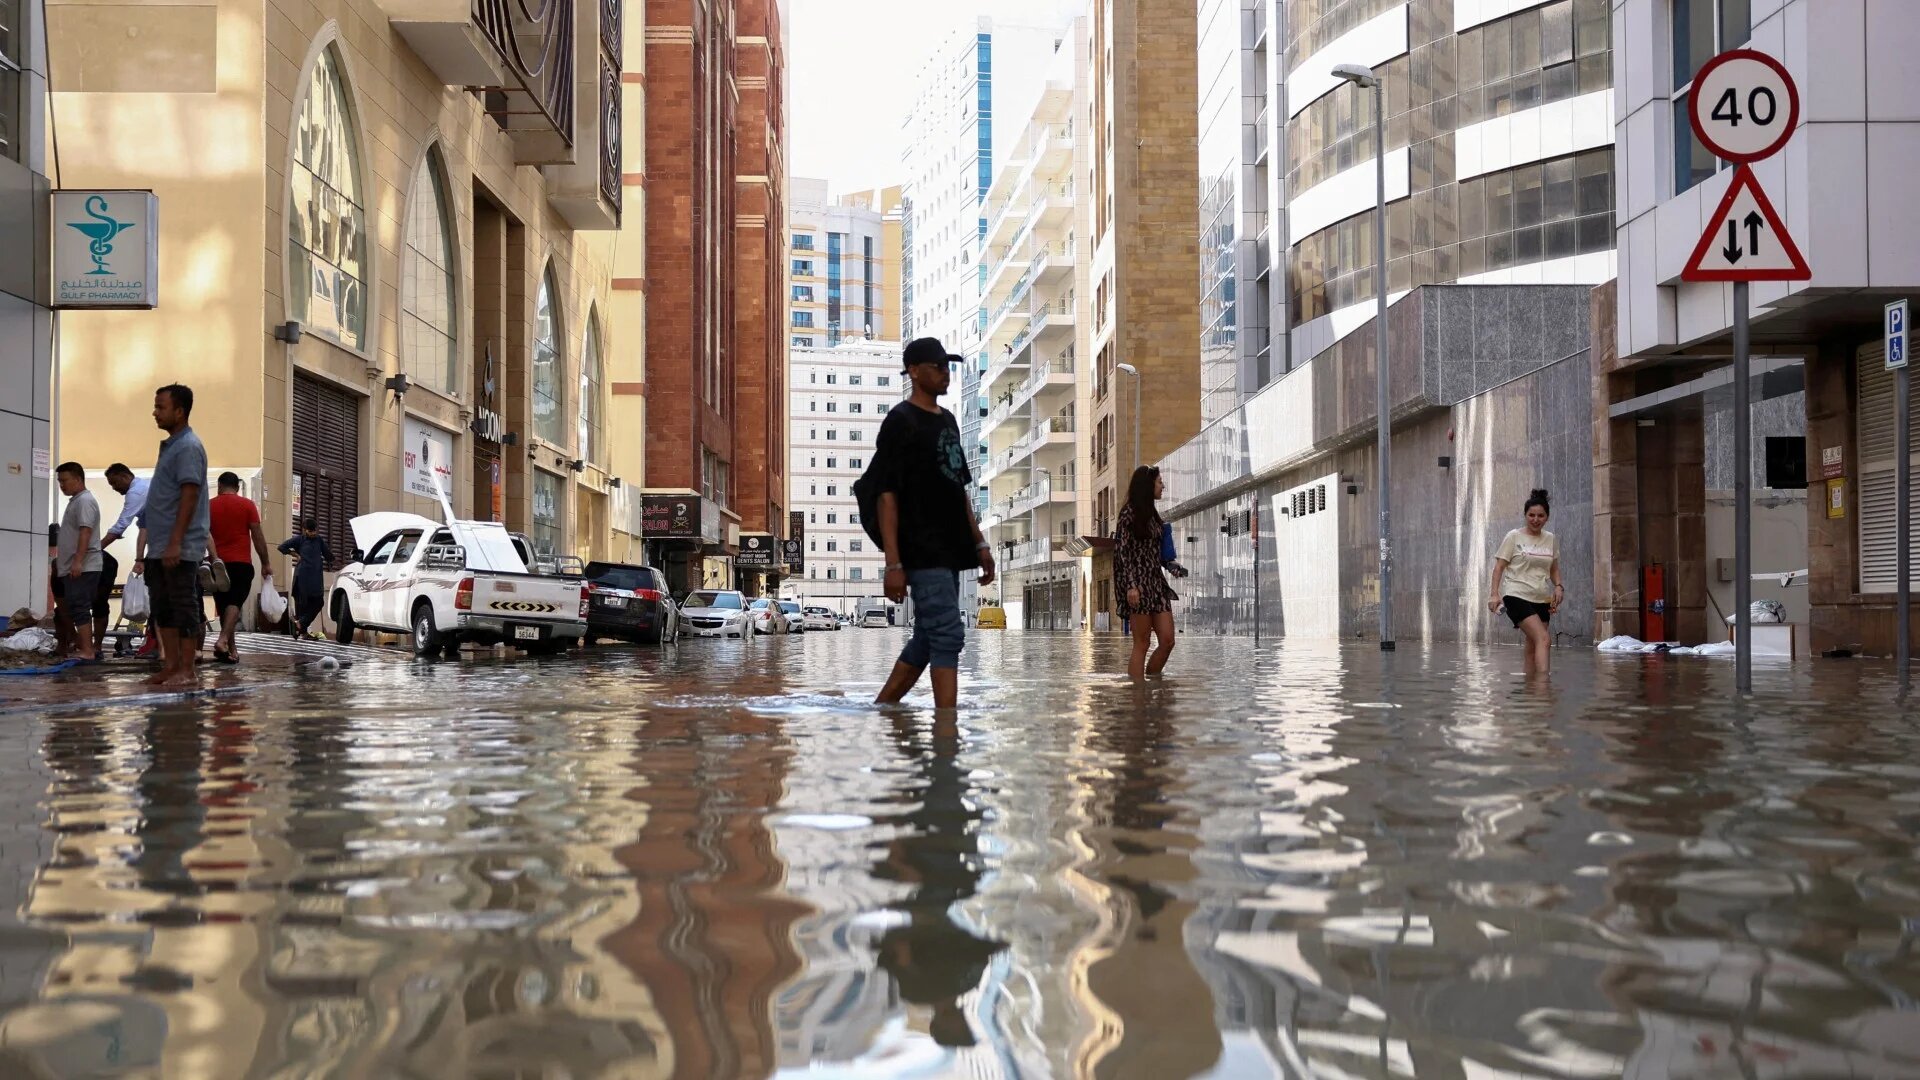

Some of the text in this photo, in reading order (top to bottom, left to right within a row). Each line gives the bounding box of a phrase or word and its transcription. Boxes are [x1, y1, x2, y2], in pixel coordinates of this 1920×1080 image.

[1711, 86, 1776, 127] 40
[61, 278, 142, 290] صيدلية الخليج
[61, 291, 142, 300] GULF PHARMACY
[1891, 310, 1901, 333] P
[478, 405, 501, 443] NOON
[404, 451, 416, 470] RENT
[642, 504, 669, 517] صالون
[642, 519, 669, 531] SALON
